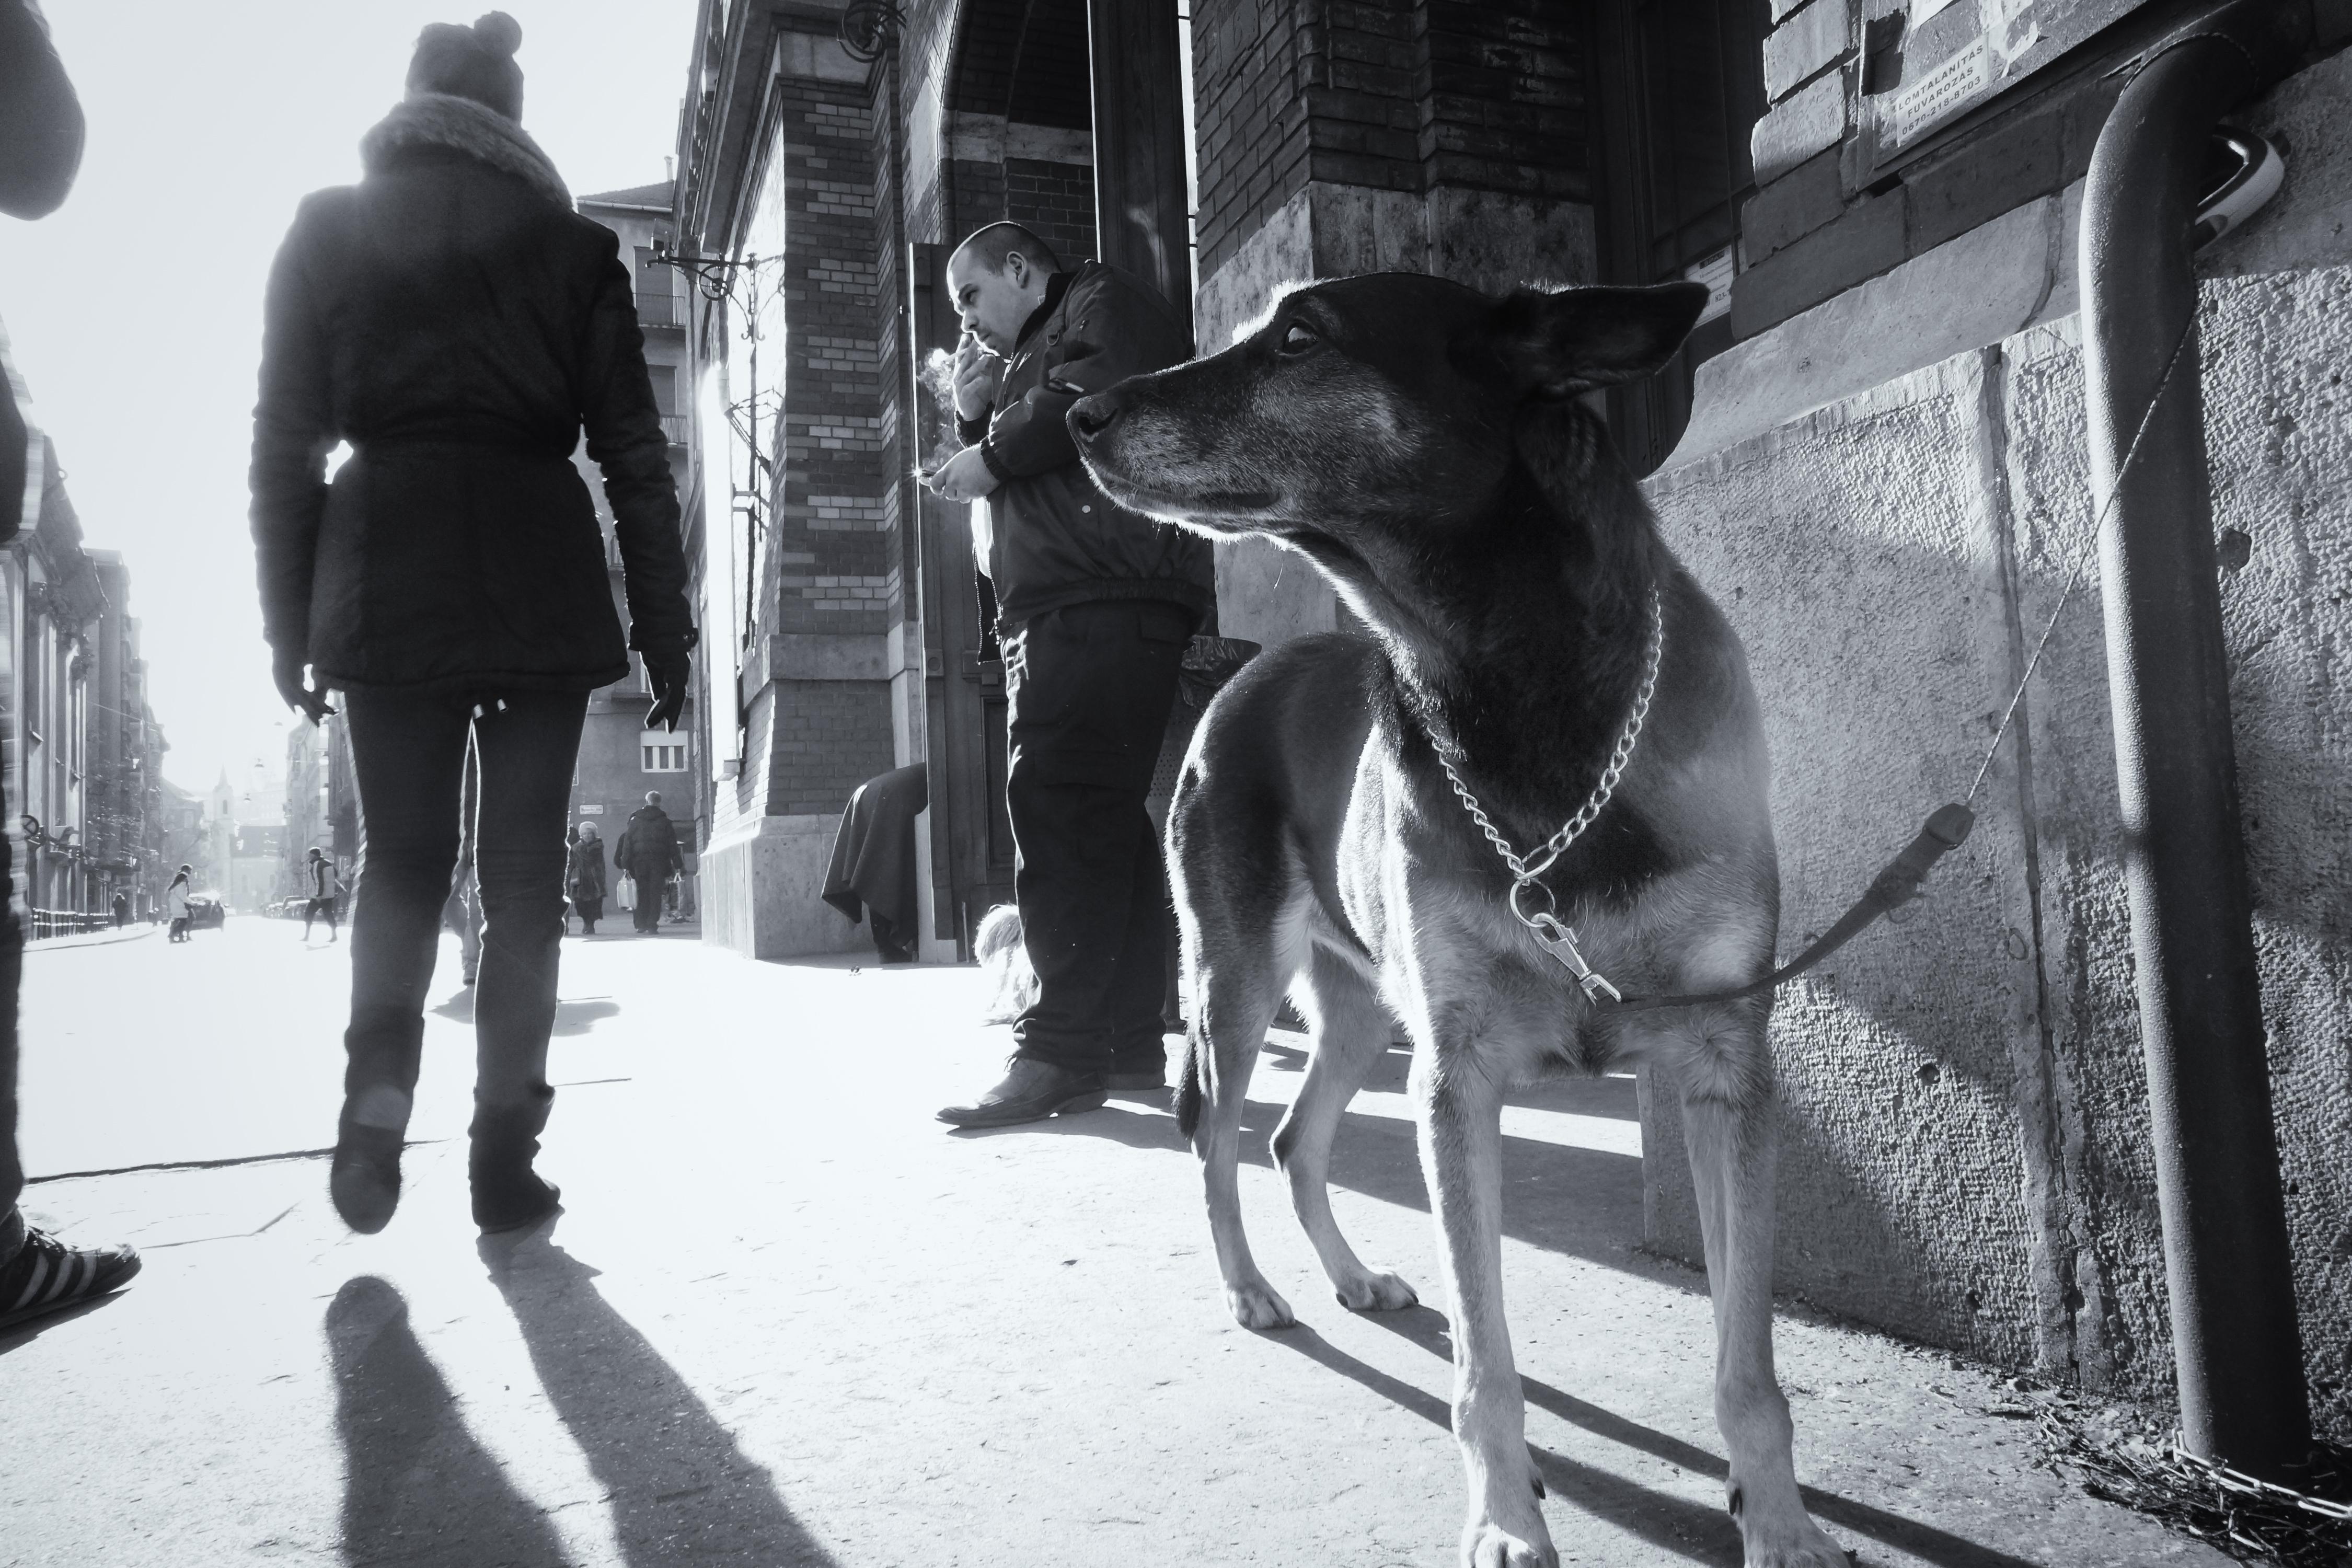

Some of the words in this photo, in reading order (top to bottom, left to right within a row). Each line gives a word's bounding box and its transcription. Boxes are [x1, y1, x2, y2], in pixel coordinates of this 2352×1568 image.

[1899, 44, 1983, 111] LOMTALANÍTÁS
[1902, 75, 1981, 135] 0670-218-8703
[1908, 66, 1974, 118] FUVAROZÁS
